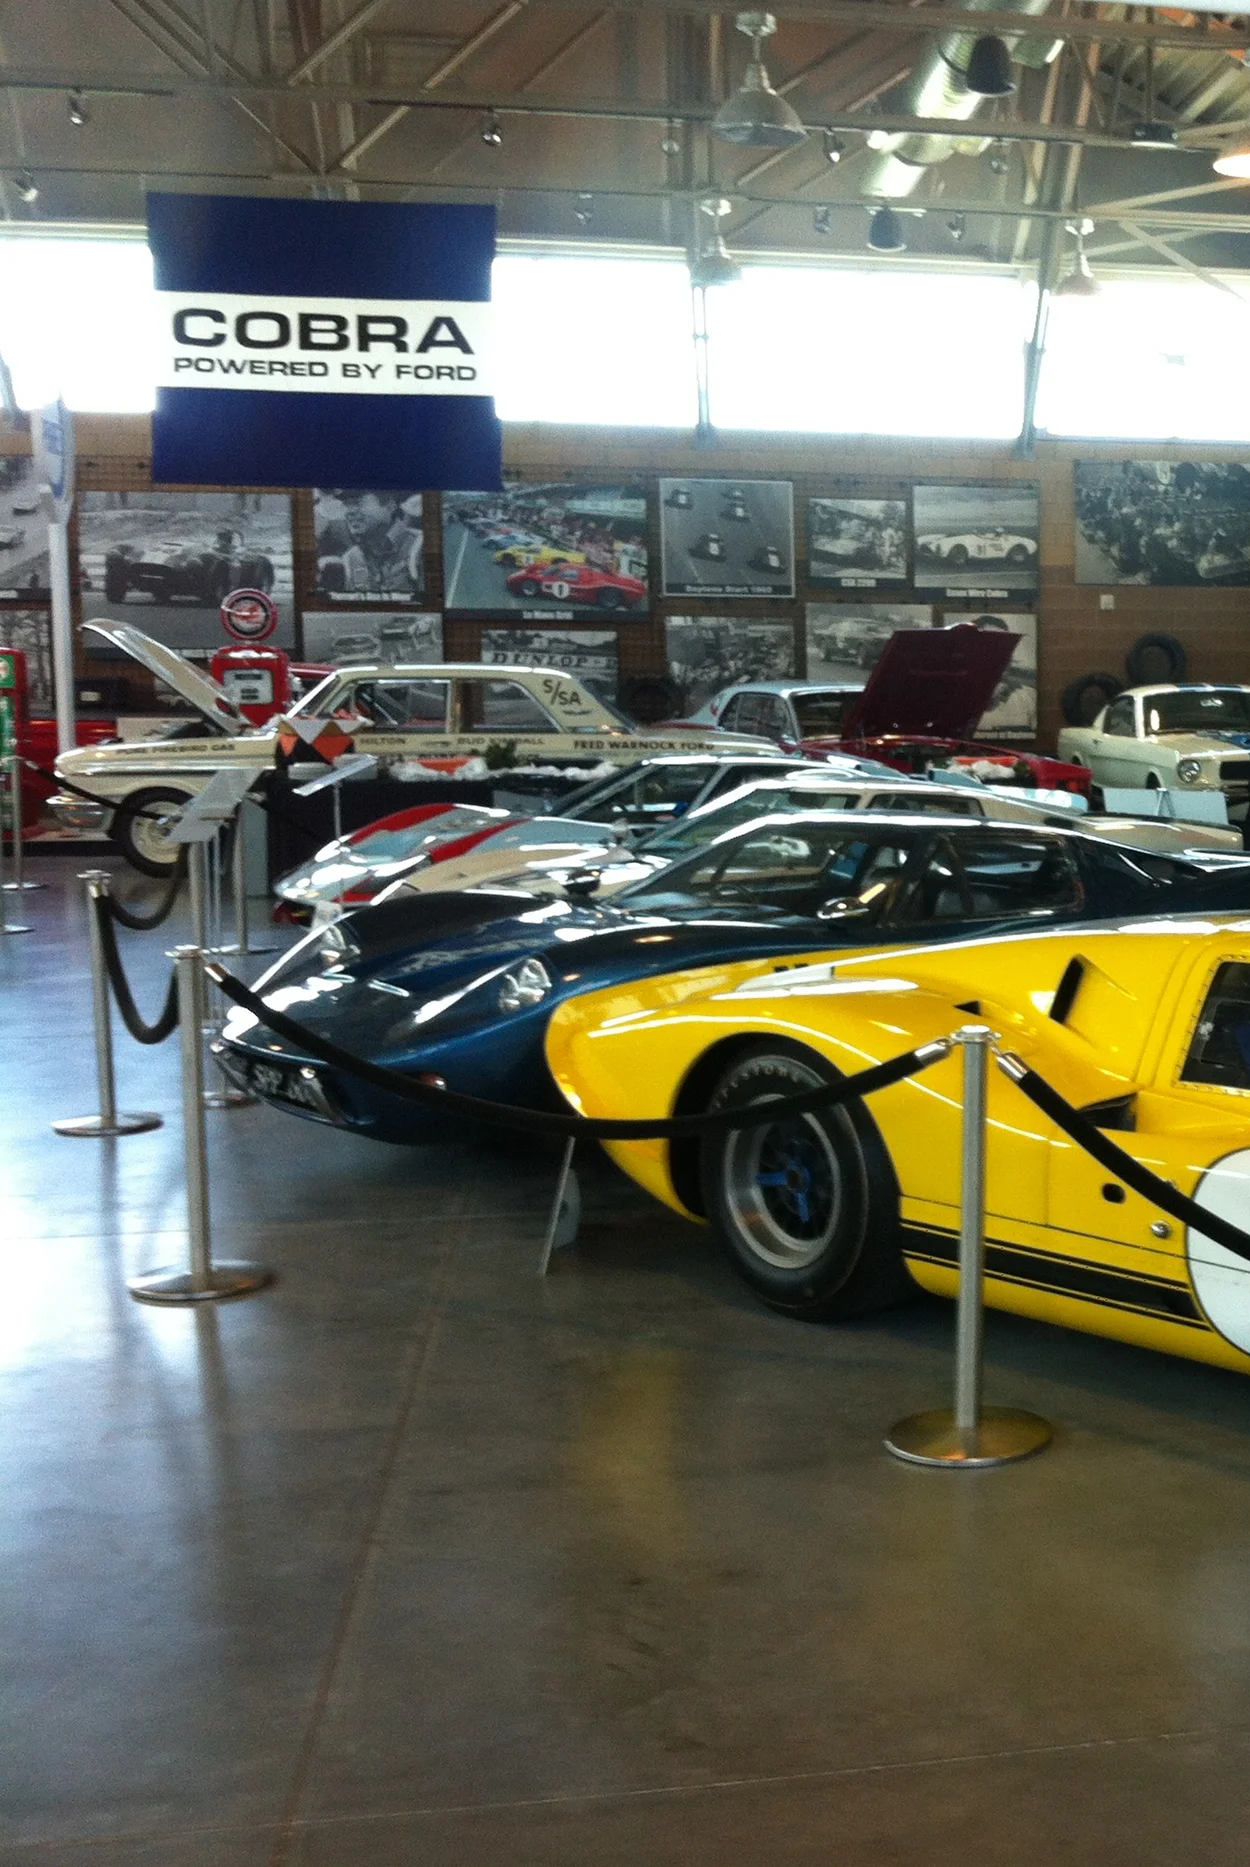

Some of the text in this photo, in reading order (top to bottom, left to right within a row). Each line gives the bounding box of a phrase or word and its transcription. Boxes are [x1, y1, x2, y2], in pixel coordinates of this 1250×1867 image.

[173, 307, 474, 355] COBRA
[174, 357, 476, 381] POWERED BY FORD
[492, 652, 588, 667] DUNLOP
[542, 678, 583, 706] S/SA
[211, 743, 236, 751] GAS
[573, 740, 605, 750] FRED
[609, 740, 677, 750] WARNOCK
